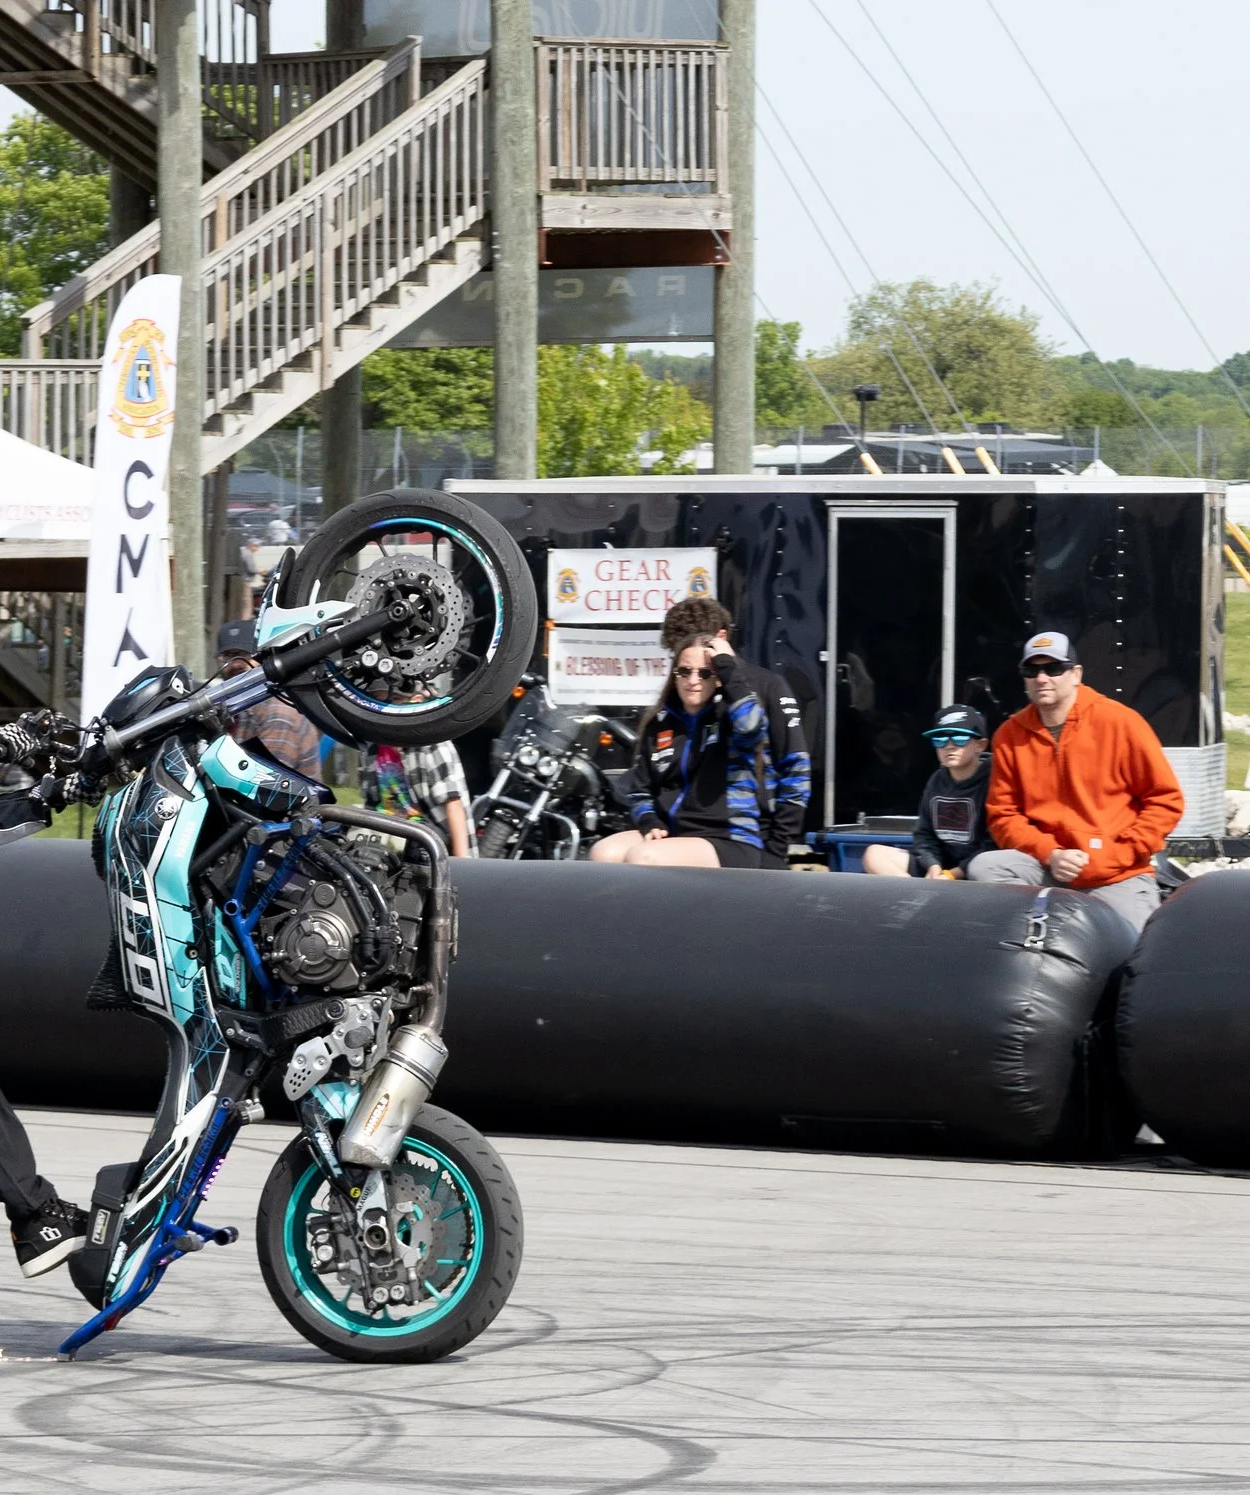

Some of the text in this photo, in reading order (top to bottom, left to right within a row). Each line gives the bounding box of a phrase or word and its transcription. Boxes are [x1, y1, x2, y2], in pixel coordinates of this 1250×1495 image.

[113, 459, 155, 668] CMA
[595, 559, 672, 582] GEAR
[584, 589, 681, 612] CHECK
